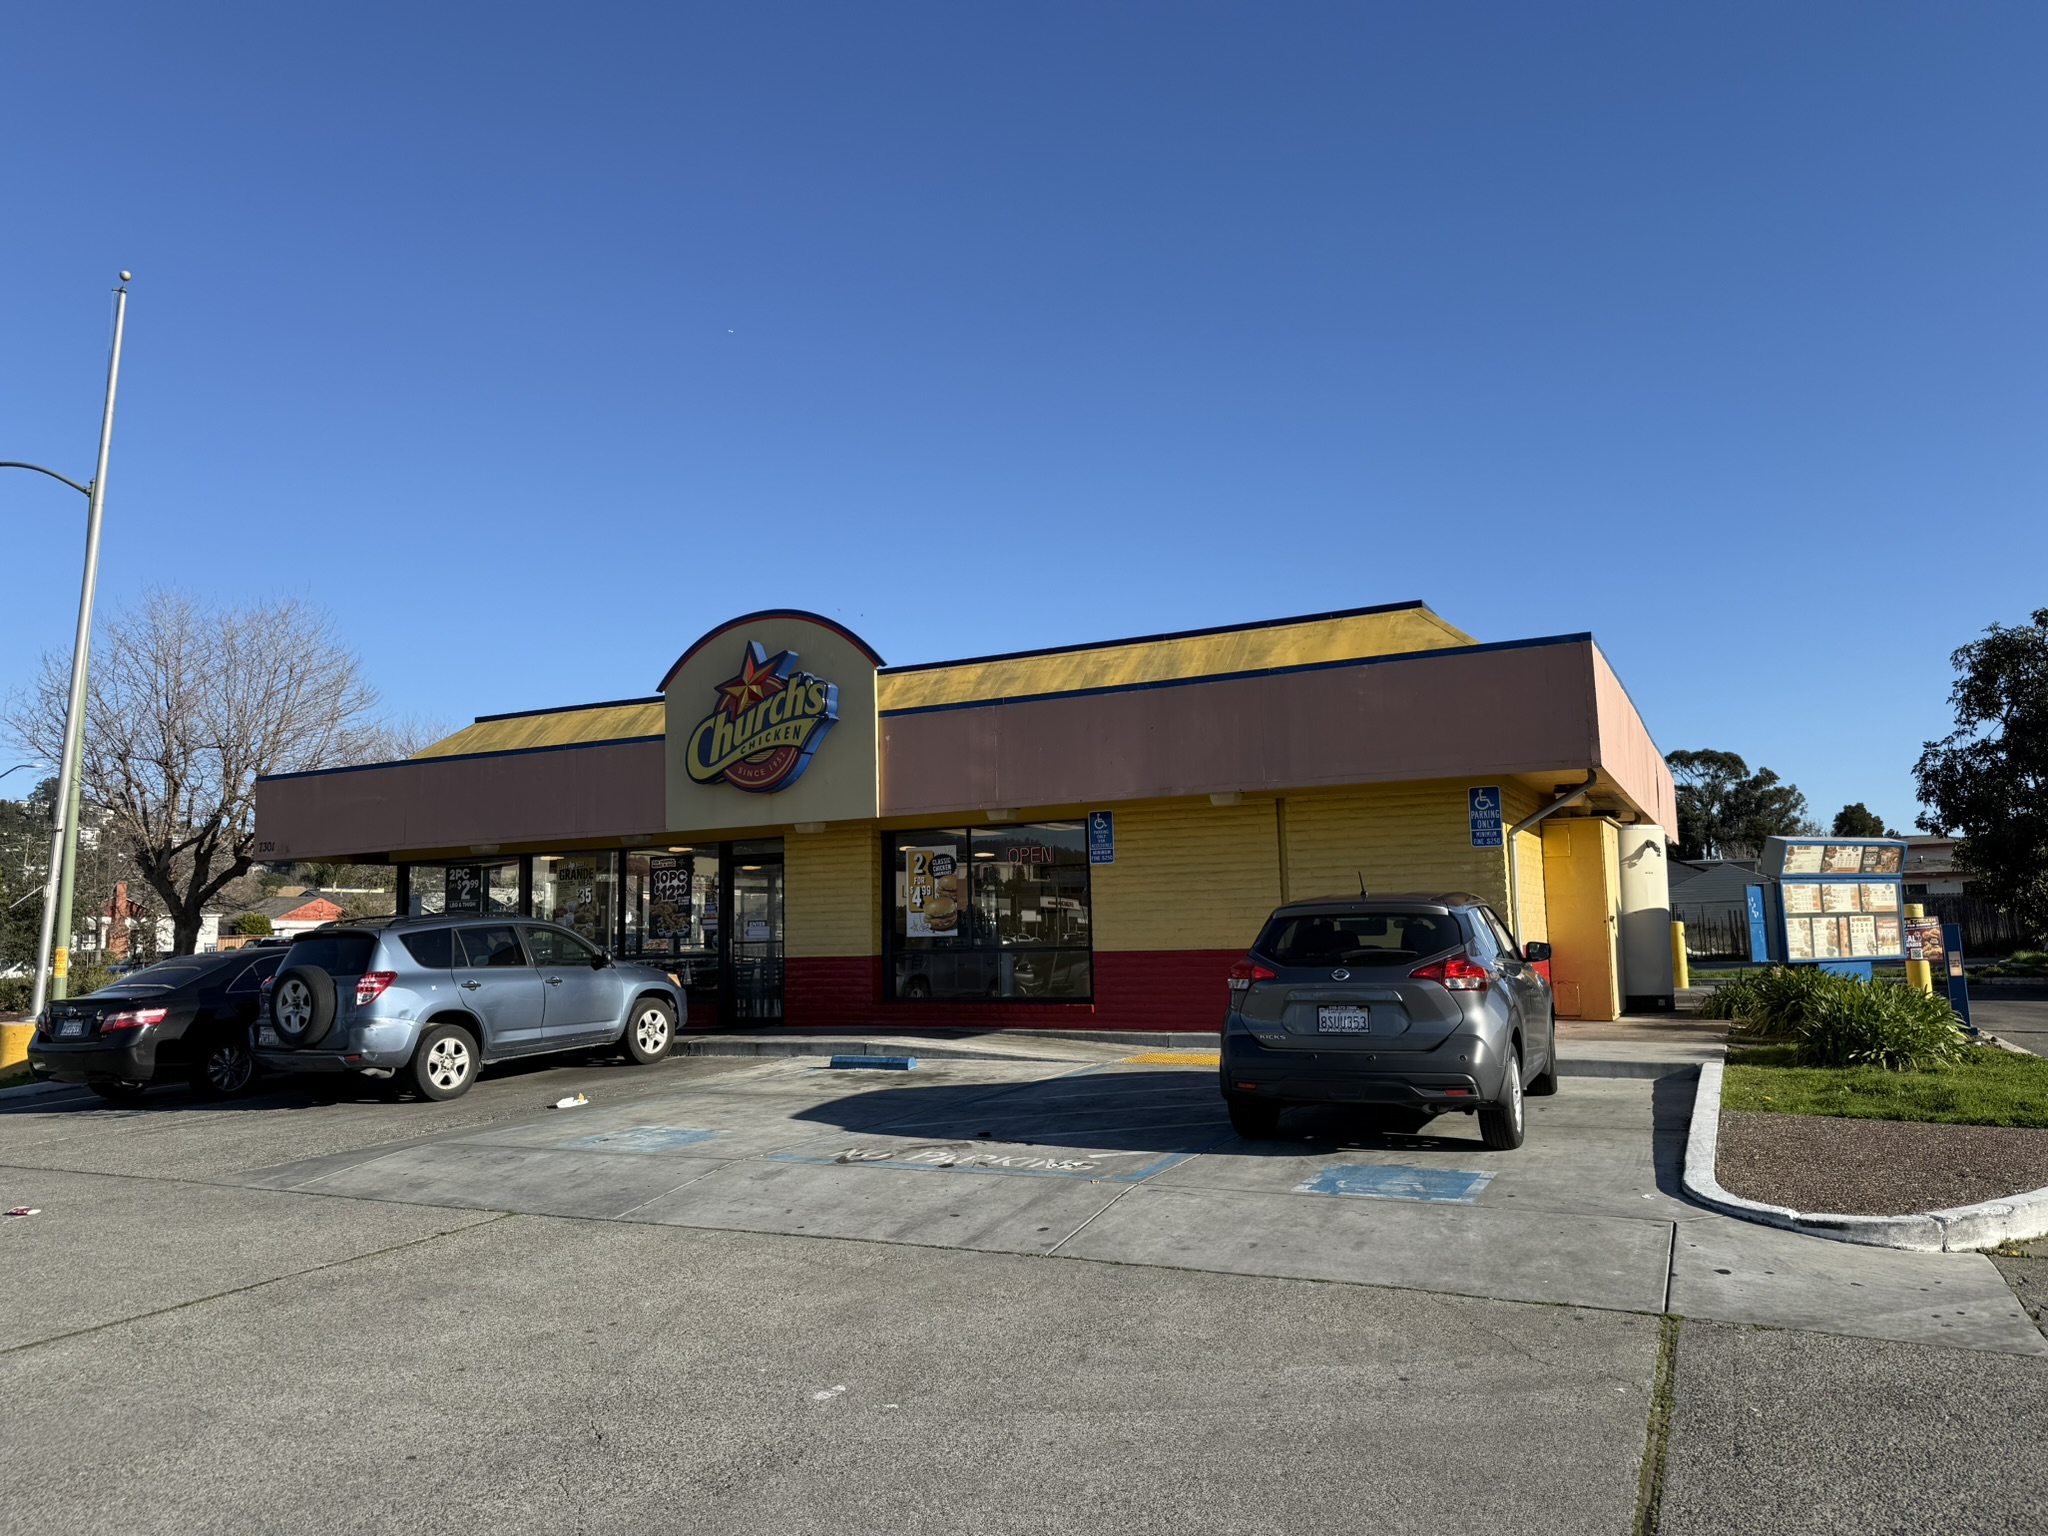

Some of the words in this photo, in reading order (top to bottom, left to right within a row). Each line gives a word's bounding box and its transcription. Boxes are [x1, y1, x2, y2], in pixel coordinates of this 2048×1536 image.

[686, 675, 823, 780] Church's
[740, 724, 802, 755] CHICKEN
[738, 765, 766, 777] SINCE
[769, 751, 787, 772] 1952
[1471, 810, 1500, 819] PARKING
[1477, 820, 1495, 829] ONLY
[259, 841, 275, 852] 7301
[1009, 847, 1052, 864] OPEN
[914, 853, 925, 875] 2
[932, 864, 952, 872] CHICKEN
[449, 868, 470, 880] 2PC
[559, 868, 594, 880] GRANDE
[653, 870, 688, 884] 10PC
[914, 876, 925, 885] FOR
[1320, 1016, 1367, 1029] 8SUU353
[904, 1150, 1101, 1170] PARKING
